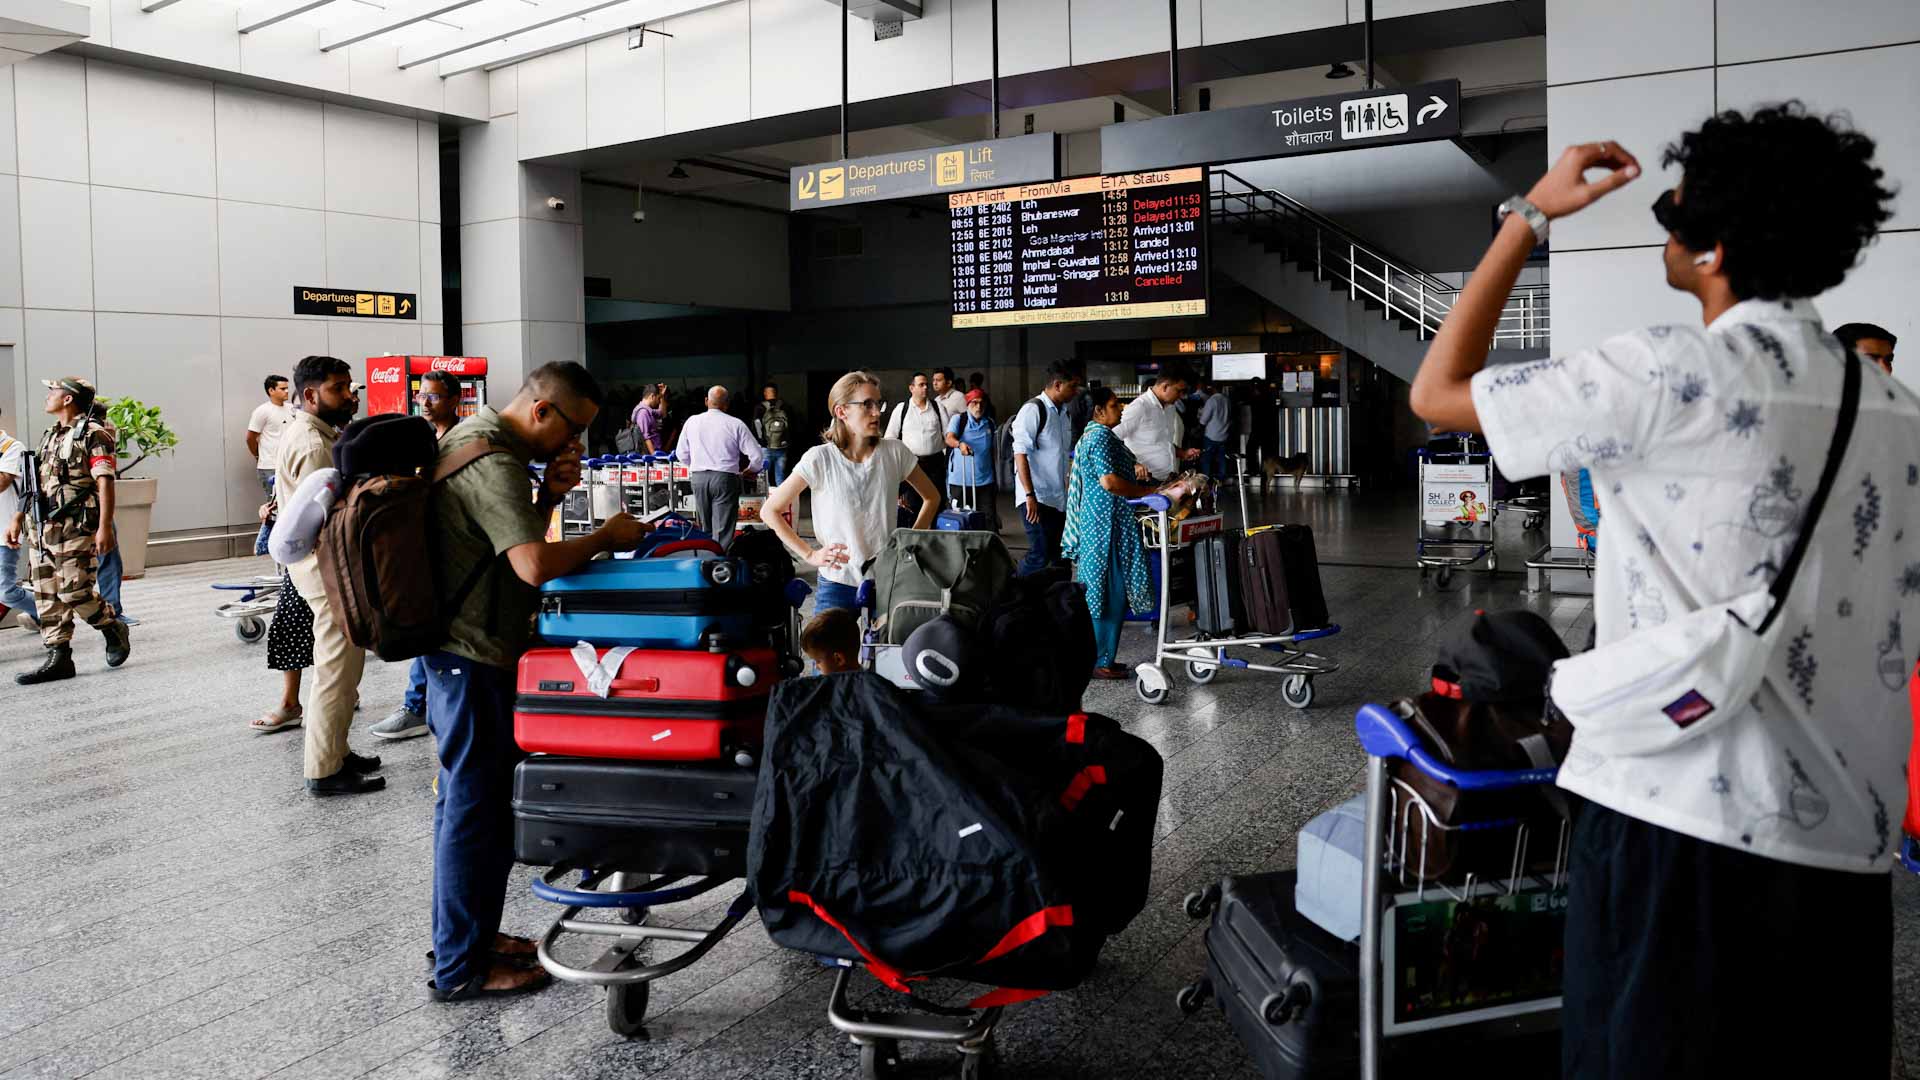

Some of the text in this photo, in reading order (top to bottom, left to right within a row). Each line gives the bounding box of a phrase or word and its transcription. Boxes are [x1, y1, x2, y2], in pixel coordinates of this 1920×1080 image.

[1272, 106, 1334, 127] Toilets
[1285, 130, 1334, 147] शौचालय
[849, 158, 926, 181] Departures
[969, 147, 993, 165] Lift
[951, 173, 1170, 206] STA Flight From/Via ETA Status
[951, 207, 973, 218] 15:20
[992, 202, 1012, 213] 2402
[1021, 200, 1038, 210] Leh
[1102, 189, 1128, 201] 14:54
[951, 219, 974, 230] 09:55
[992, 213, 1012, 225] 2365
[1021, 208, 1081, 222] Bhubaneswar
[1102, 202, 1128, 214] 11:53
[1133, 197, 1173, 210] Delayed
[1174, 194, 1201, 206] 11:53
[951, 230, 974, 241] 12:55
[992, 226, 1013, 237] 2015
[1022, 224, 1038, 234] Leh
[1133, 210, 1173, 223] Delayed
[1174, 207, 1200, 219] 13:28
[951, 242, 975, 253] 13:00
[992, 238, 1013, 249] 2102
[1030, 235, 1049, 246] Goa
[1103, 227, 1129, 239] 12:52
[1133, 224, 1168, 236] Arrived
[1170, 221, 1194, 233] 13:01
[952, 254, 975, 265] 13:00
[992, 250, 1013, 261] 6042
[1022, 245, 1075, 259] Ahmedabad
[1103, 241, 1129, 252] 13:12
[1134, 237, 1169, 249] Landed
[952, 266, 975, 277] 13:05
[1023, 259, 1051, 272] Imphal
[1058, 255, 1100, 268] Guwahati
[1103, 253, 1129, 264] 12:58
[1134, 250, 1169, 262] Arrived
[1170, 247, 1197, 259] 13:10
[953, 278, 976, 288] 13:10
[993, 274, 1014, 286] 2137
[1023, 273, 1056, 284] Jammu
[1063, 269, 1101, 281] Srinagar
[1104, 265, 1130, 277] 12:54
[1134, 262, 1170, 275] Arrived
[1171, 260, 1197, 272] 12:59
[953, 290, 976, 300] 13:10
[994, 287, 1013, 298] 2221
[1023, 284, 1058, 296] Mumbai
[1135, 274, 1183, 287] Cancelled
[302, 290, 356, 304] Departures
[953, 301, 976, 313] 13:15
[994, 299, 1015, 310] 2099
[1023, 297, 1058, 309] Udaipur
[1104, 291, 1130, 303] 13:18
[1037, 309, 1087, 321] International
[1089, 307, 1119, 319] Airport
